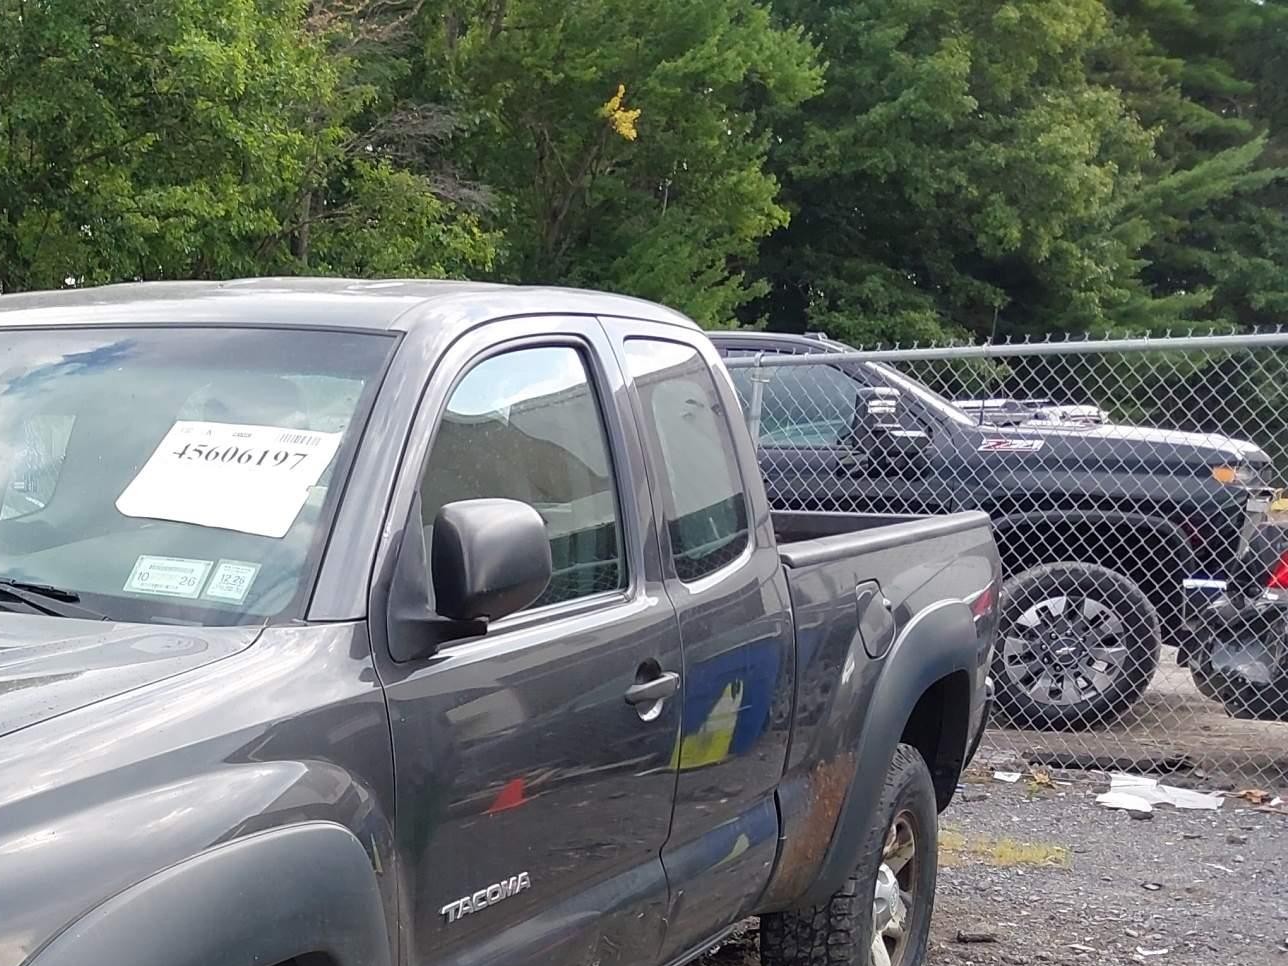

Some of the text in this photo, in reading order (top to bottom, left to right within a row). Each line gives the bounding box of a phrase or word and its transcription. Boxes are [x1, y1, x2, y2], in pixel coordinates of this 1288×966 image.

[172, 442, 308, 471] 45606197
[137, 571, 150, 582] 10
[178, 575, 197, 587] 26
[440, 871, 532, 923] TACOMA
